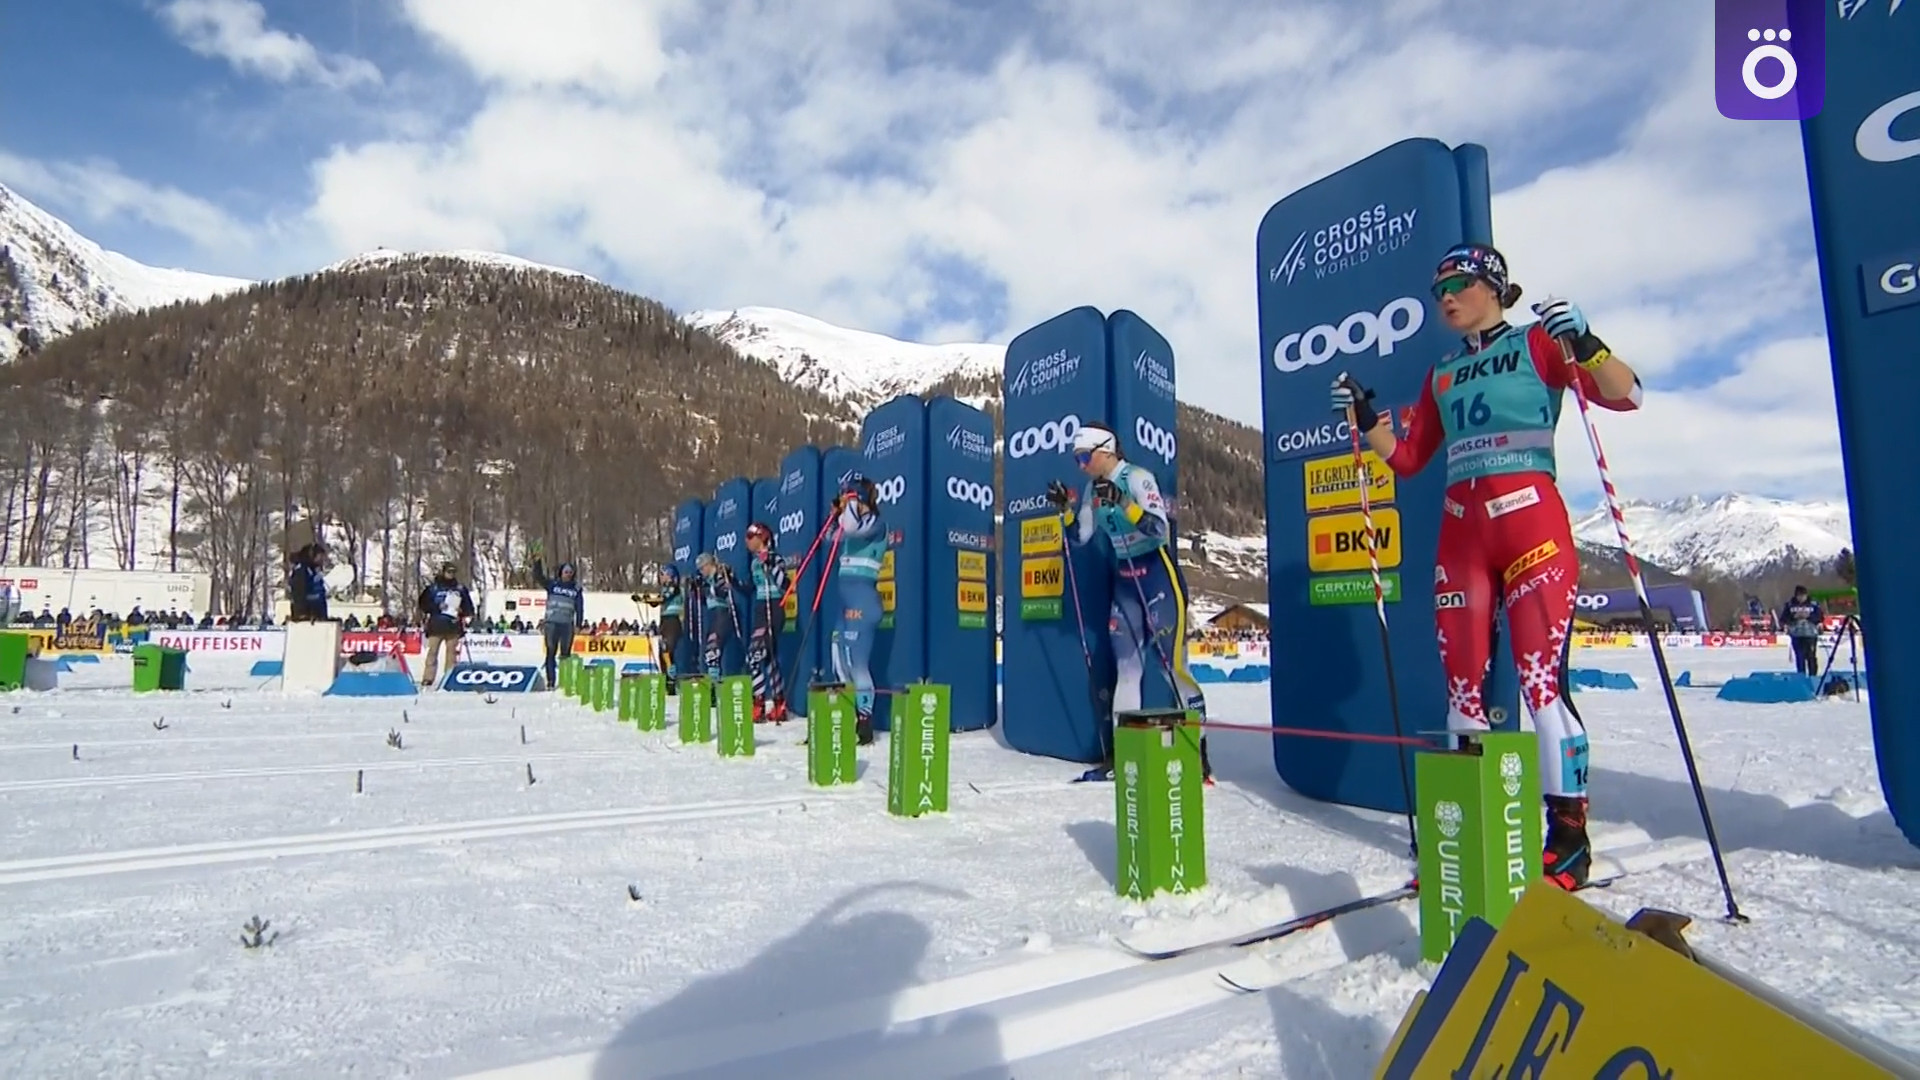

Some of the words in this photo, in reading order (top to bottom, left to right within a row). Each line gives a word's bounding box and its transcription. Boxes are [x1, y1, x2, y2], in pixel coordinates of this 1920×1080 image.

[1314, 203, 1387, 248] CROSS
[1314, 208, 1418, 266] COUNTRY
[1314, 250, 1370, 280] WORLD
[1377, 233, 1412, 256] CUP
[1274, 297, 1425, 373] coop
[1031, 349, 1067, 375] CROSS
[1031, 355, 1081, 387] COUNTRY
[1147, 356, 1169, 380] CROSS
[1454, 351, 1520, 386] BKW
[1451, 392, 1492, 431] 16
[1009, 414, 1081, 459] coop
[1136, 416, 1176, 465] coop
[1277, 420, 1363, 452] GOMS.C
[946, 475, 994, 511] coop
[1310, 470, 1324, 486] LE
[1491, 491, 1535, 514] Scandic
[779, 510, 804, 534] coop
[1335, 527, 1391, 553] BKW
[1034, 568, 1060, 585] BKW
[1510, 547, 1552, 578] DHL
[1315, 579, 1375, 594] CERTINA
[1436, 592, 1463, 609] on
[1505, 570, 1549, 609] CRAFT
[1576, 594, 1609, 610] op
[159, 636, 262, 651] RAIFFEISEN
[343, 636, 406, 654] unrise
[587, 639, 626, 652] BKW
[456, 669, 524, 688] coop
[917, 716, 934, 808] CERTINA
[1125, 787, 1142, 895] CERTINA
[1167, 786, 1187, 895] CERTINA
[1438, 841, 1463, 961] CERTI
